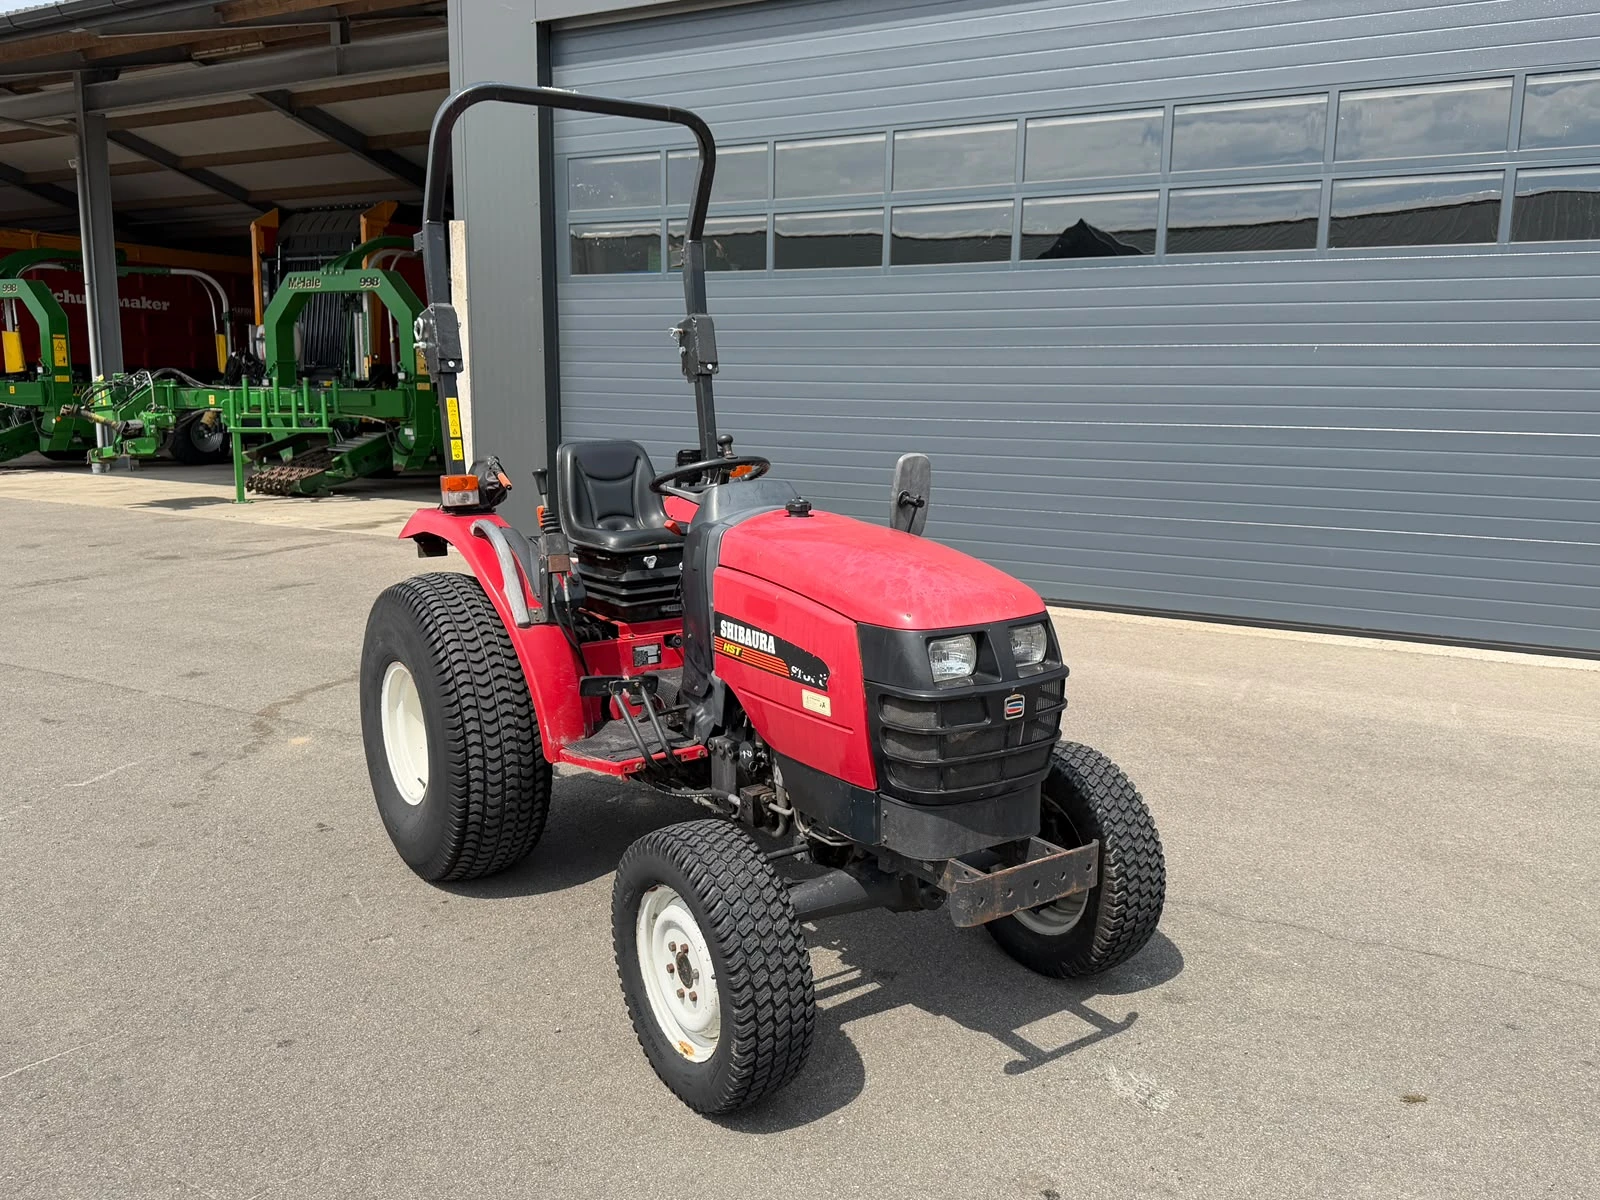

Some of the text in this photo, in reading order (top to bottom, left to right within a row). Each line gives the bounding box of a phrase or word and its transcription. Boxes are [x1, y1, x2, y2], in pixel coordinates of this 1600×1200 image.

[2, 283, 18, 294] 998
[288, 276, 381, 290] McHale 998
[720, 619, 776, 655] SHIBAURA
[723, 642, 742, 656] HST
